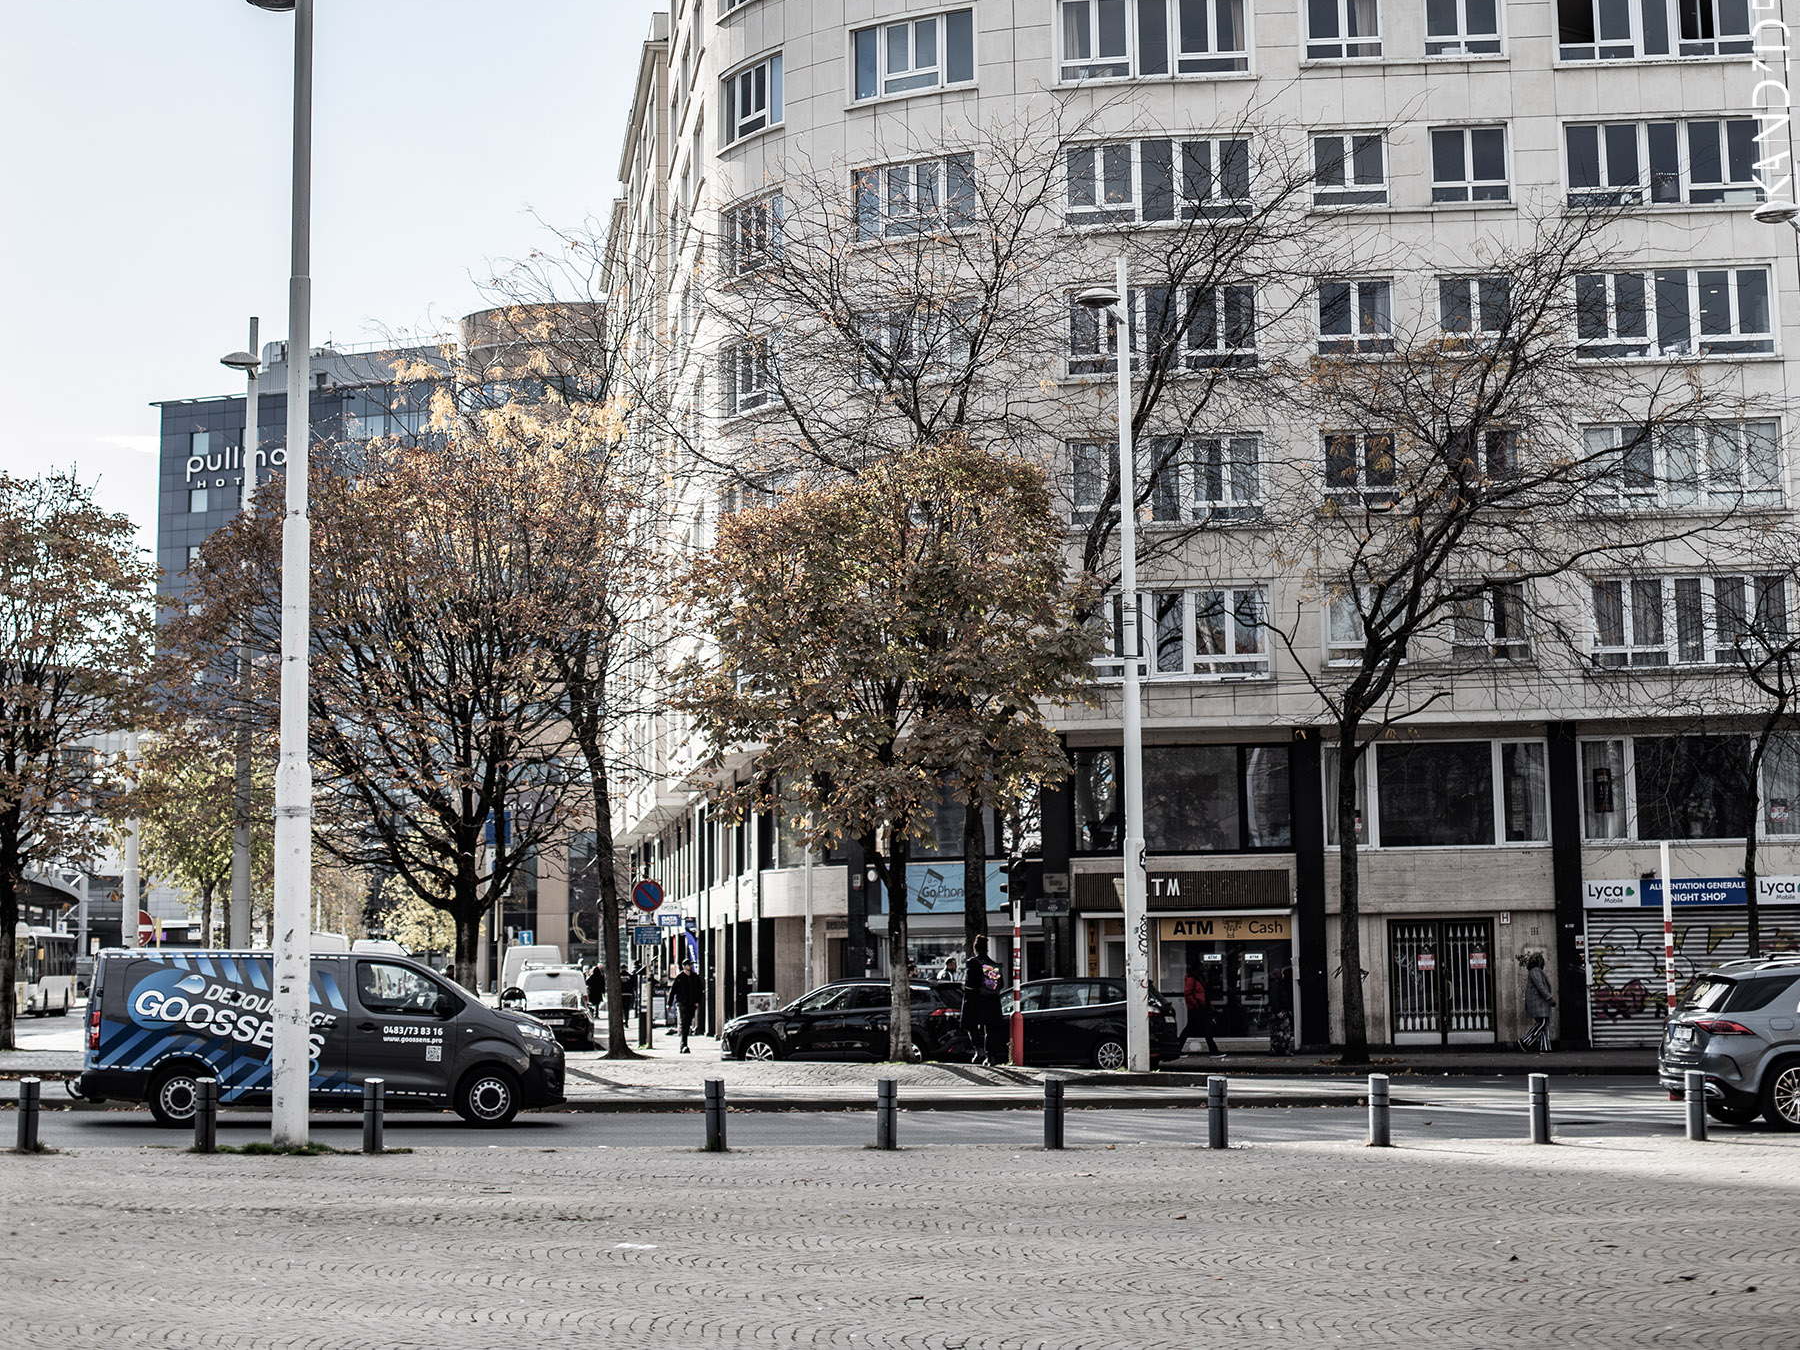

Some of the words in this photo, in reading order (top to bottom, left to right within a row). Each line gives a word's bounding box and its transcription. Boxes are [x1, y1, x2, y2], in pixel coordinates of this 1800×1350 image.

[186, 446, 288, 483] pullma
[922, 885, 964, 898] GoPhon
[1146, 878, 1181, 897] TM
[1588, 884, 1624, 900] Lyca
[1649, 882, 1705, 891] ALIENTATION
[1706, 881, 1746, 890] GENERALE
[1760, 881, 1796, 897] Lyca
[1670, 893, 1699, 902] NIGHT
[1700, 892, 1727, 901] SHOP
[1775, 893, 1796, 901] Mobile
[1173, 921, 1213, 935] ATM
[1248, 920, 1283, 934] Cash
[204, 984, 337, 1029] DEBOUGE
[135, 990, 326, 1060] GOOSSES
[383, 1026, 419, 1036] 0483/73
[420, 1027, 431, 1036] 83
[432, 1027, 444, 1036] 16
[383, 1036, 443, 1044] www.goossens.pro
